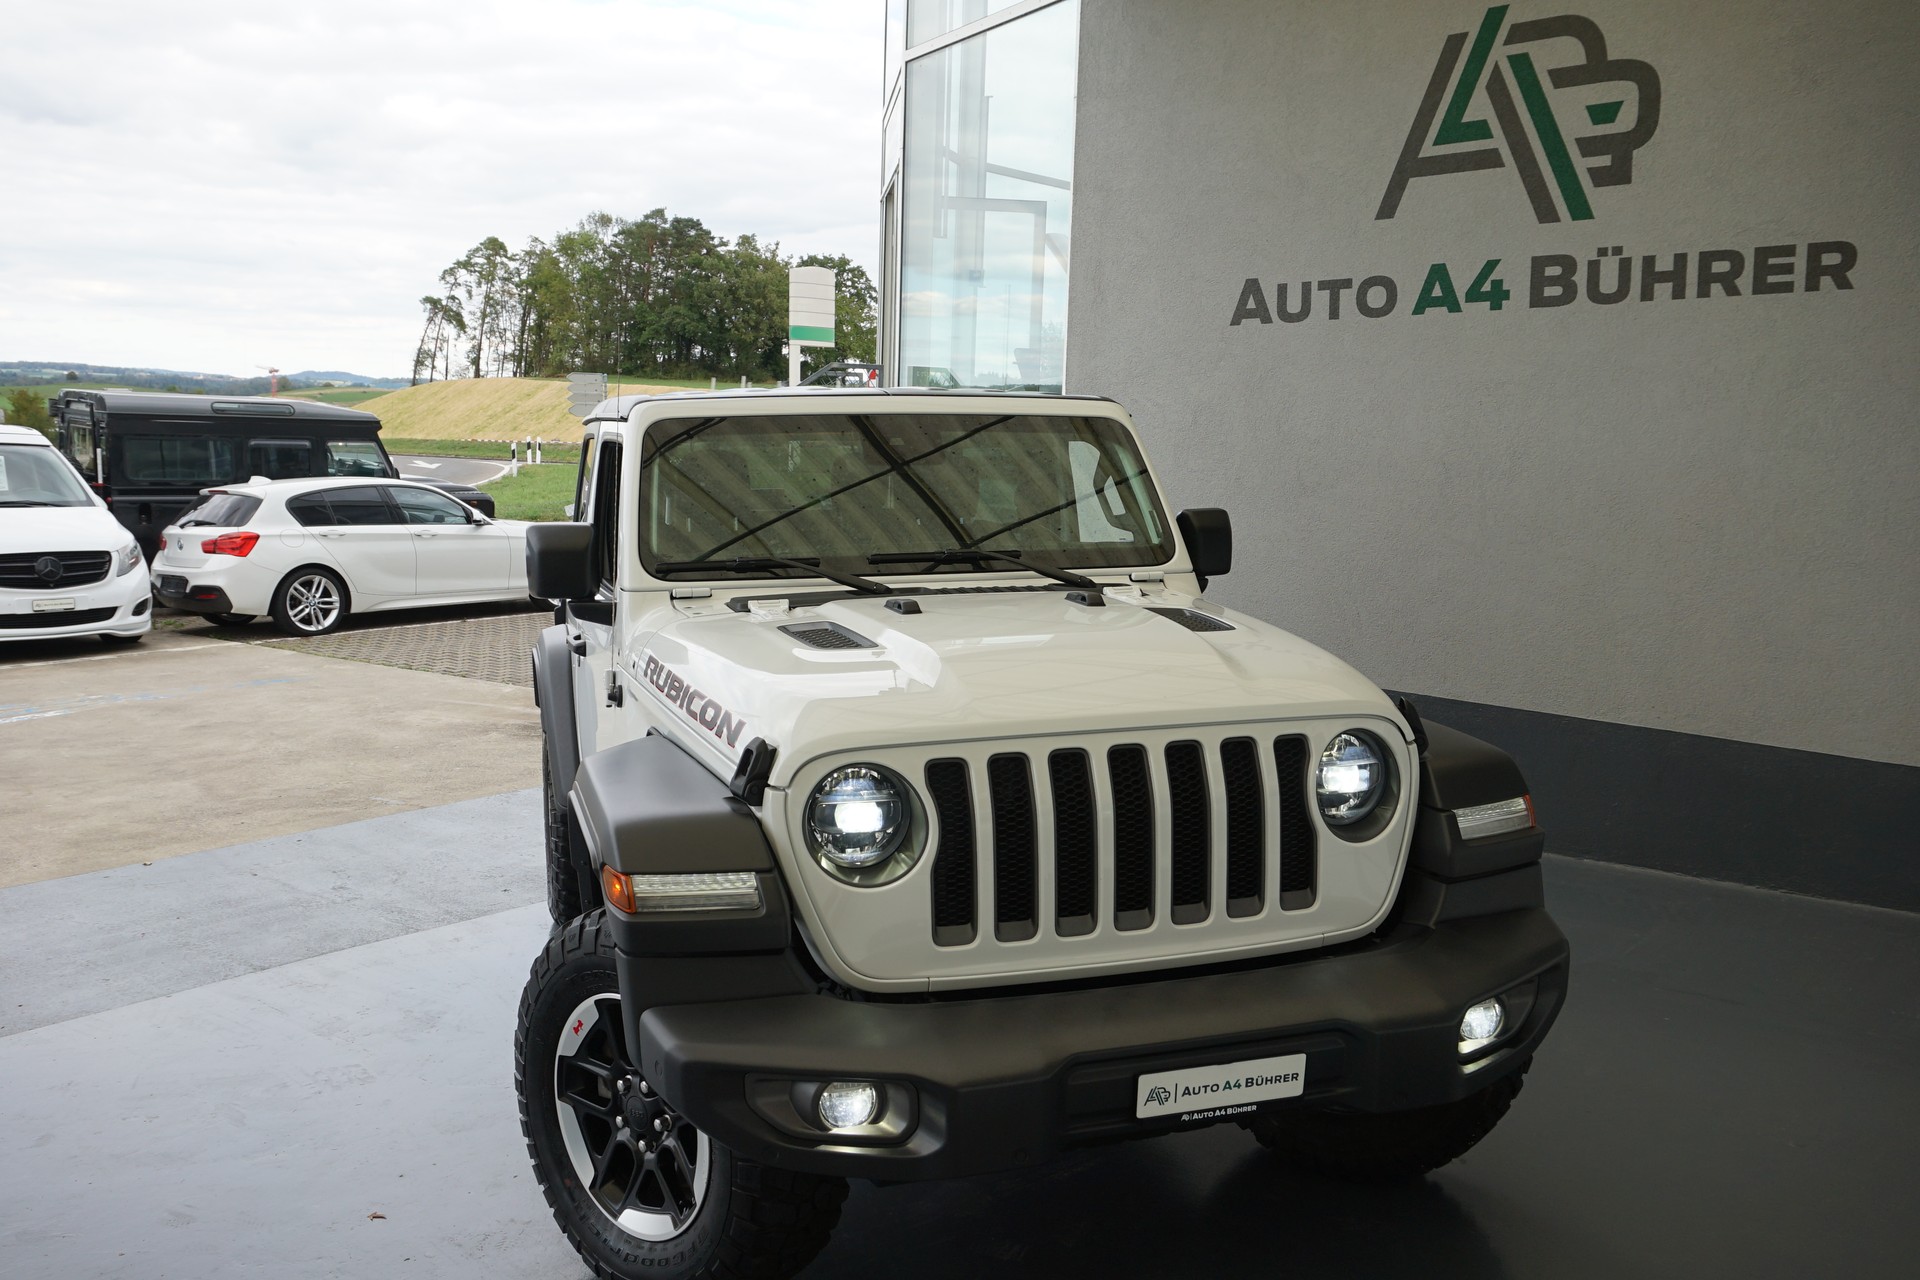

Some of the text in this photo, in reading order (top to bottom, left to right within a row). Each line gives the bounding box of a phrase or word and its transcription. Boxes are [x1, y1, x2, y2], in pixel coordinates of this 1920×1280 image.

[1230, 240, 1859, 326] AUTO A4 BÜHRER
[643, 654, 747, 748] RUBICON
[1181, 1072, 1300, 1097] AUTO A4 BÜHRER
[1192, 1111, 1214, 1120] AUTO
[1214, 1109, 1226, 1117] A4
[1226, 1105, 1257, 1115] BÜHRER
